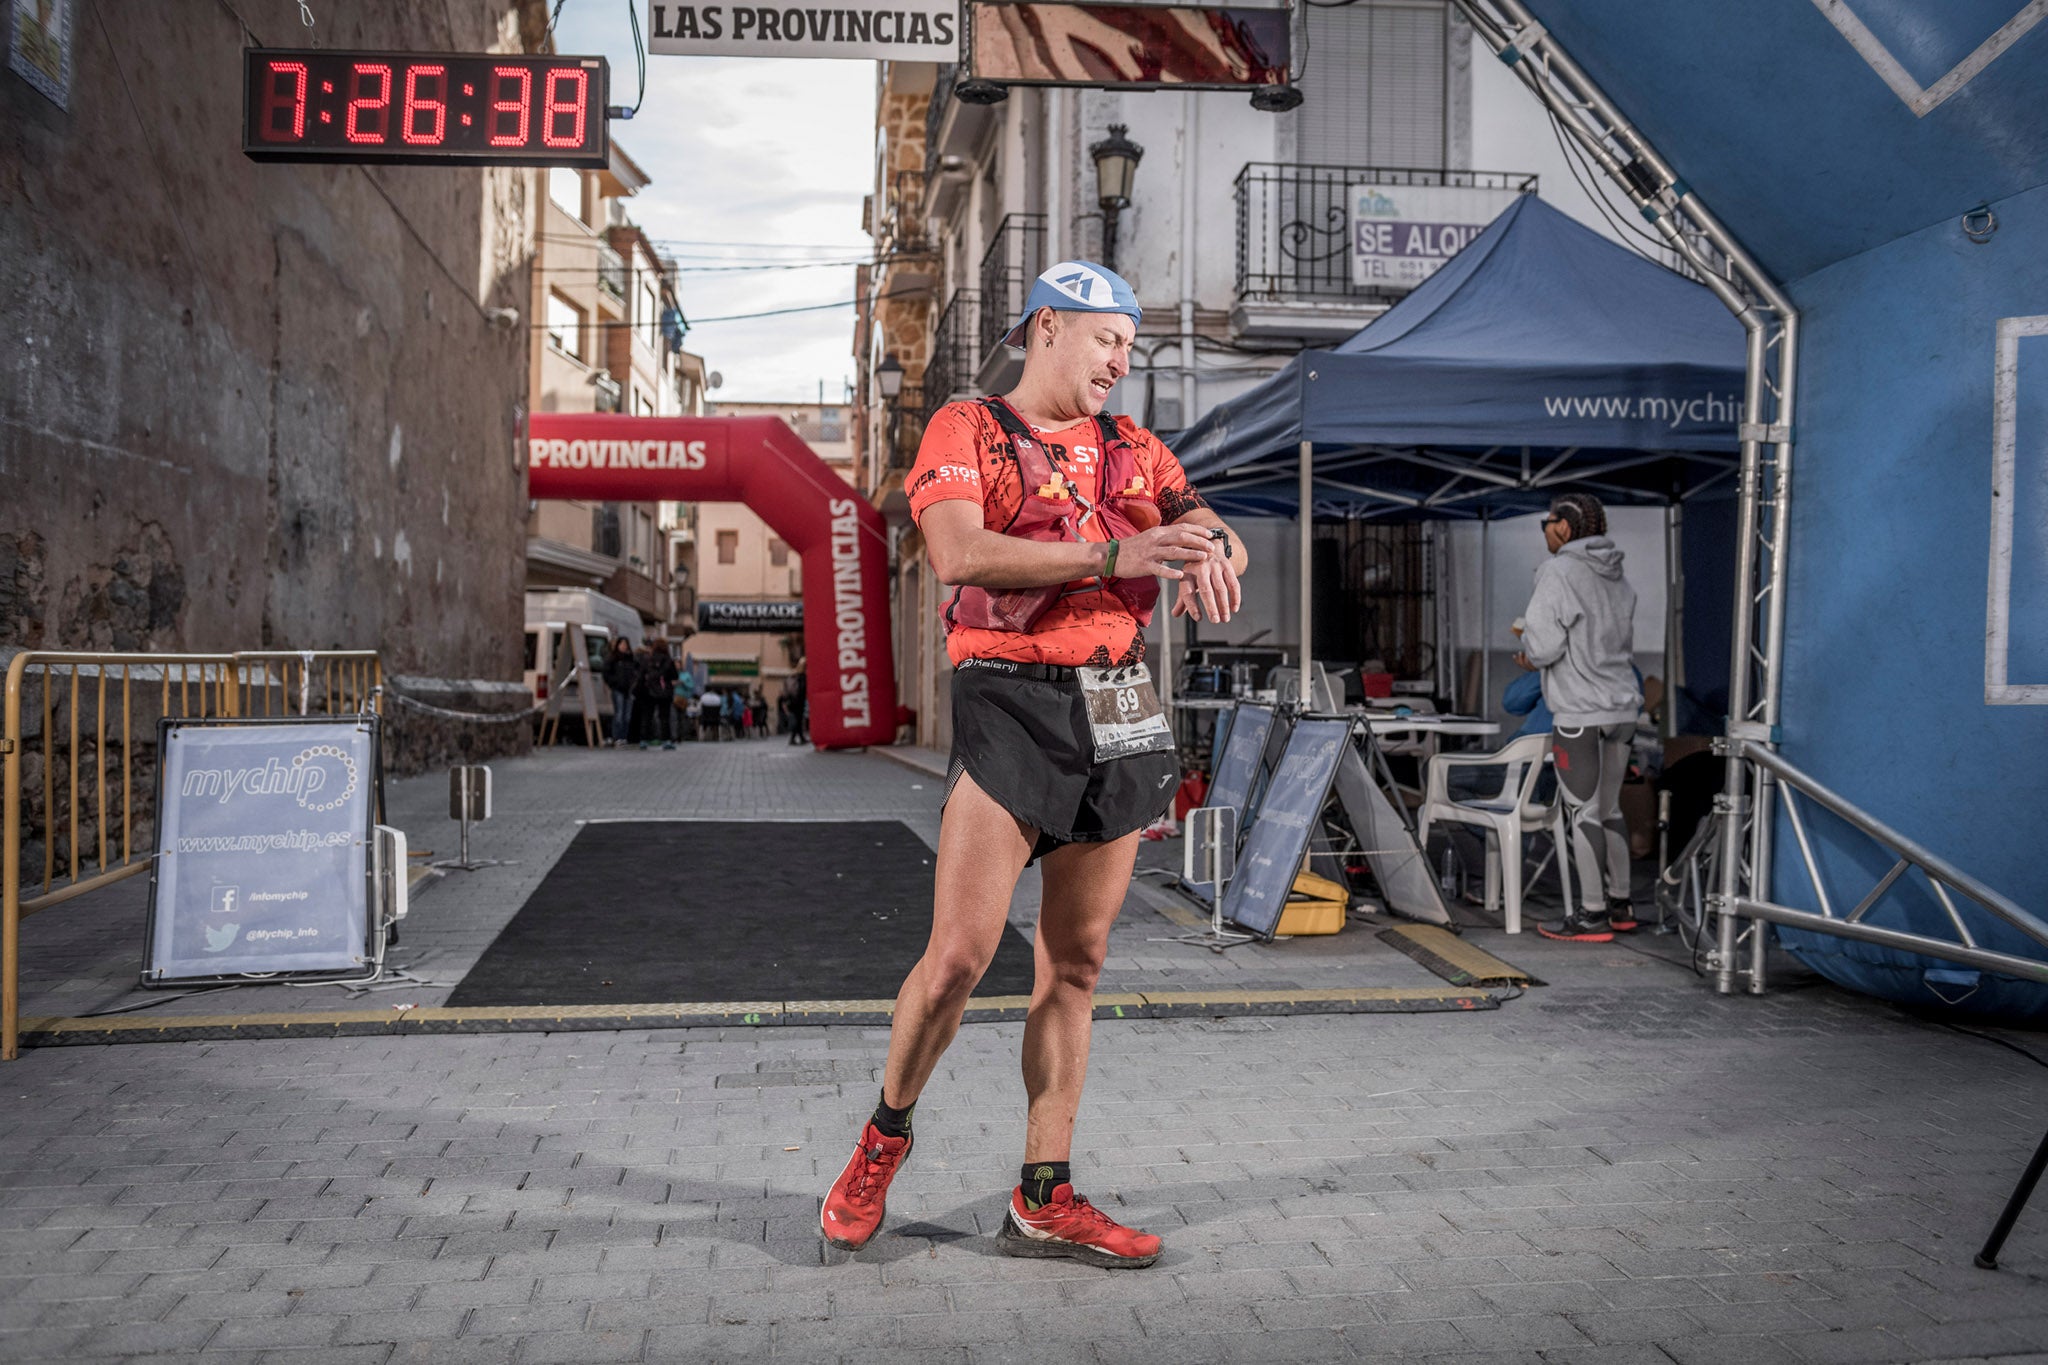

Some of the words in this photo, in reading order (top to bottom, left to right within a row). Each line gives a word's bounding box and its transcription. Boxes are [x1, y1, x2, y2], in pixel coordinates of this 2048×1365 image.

[653, 5, 723, 40] LAS
[732, 7, 954, 45] PROVINCIAS
[269, 61, 588, 148] 7:26:38
[1360, 223, 1393, 253] SE
[1405, 225, 1484, 256] ALQU
[529, 438, 706, 470] PROVINCIAS
[940, 465, 979, 480] STOP
[829, 498, 867, 669] PROVINCIAS
[974, 660, 1018, 673] Kalenji
[840, 672, 870, 728] LAS
[1117, 688, 1140, 712] 69
[182, 757, 326, 804] mychip
[178, 829, 351, 854] www.mychip.es
